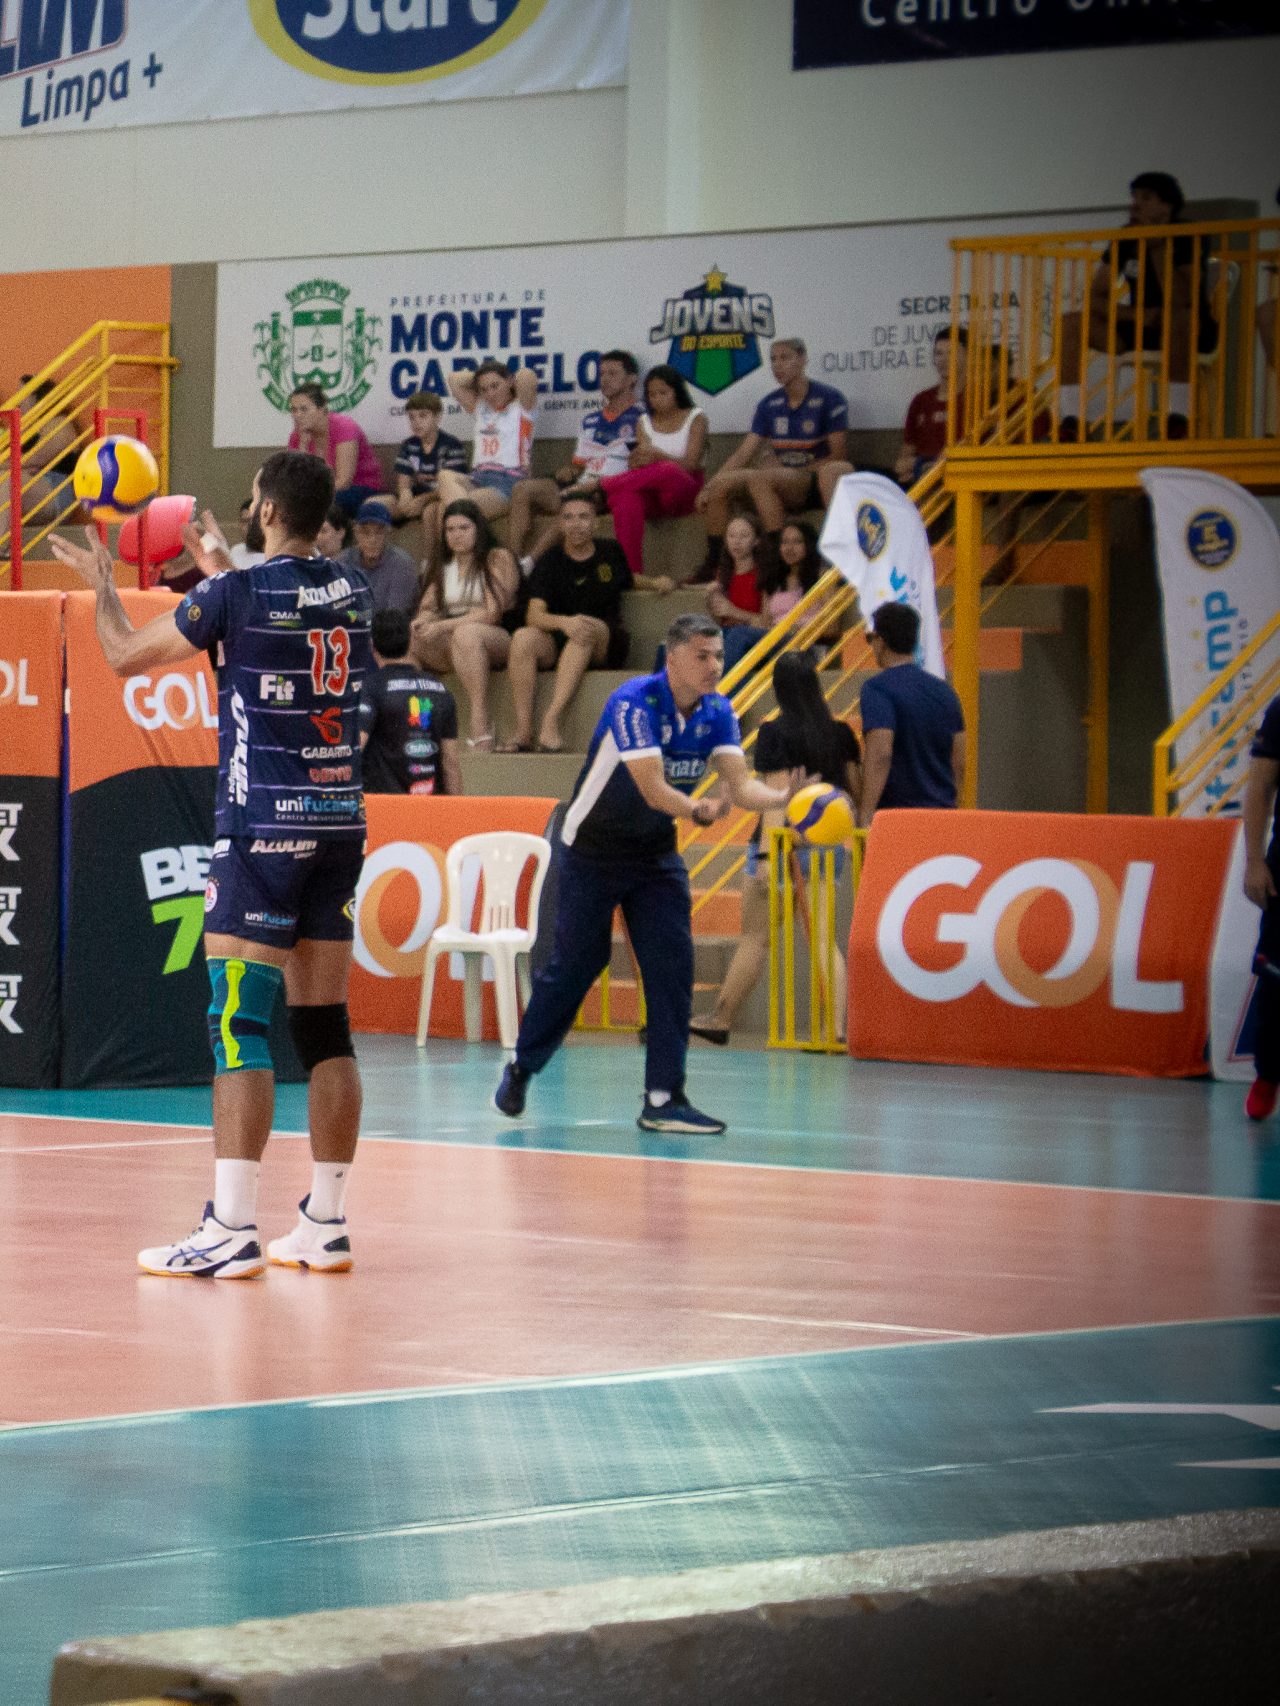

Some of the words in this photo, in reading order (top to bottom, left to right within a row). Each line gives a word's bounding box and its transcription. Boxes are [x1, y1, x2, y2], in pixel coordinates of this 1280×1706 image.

[21, 59, 130, 128] Limpa
[390, 291, 508, 307] PREFEITURA
[524, 289, 546, 301] DE
[650, 293, 775, 344] JOVENS
[390, 307, 545, 354] MONTE
[874, 325, 898, 347] DE
[822, 349, 909, 373] CULTURA
[270, 610, 301, 620] CMAA
[308, 626, 350, 696] 13
[122, 671, 219, 731] GOL
[259, 673, 296, 700] Fit
[140, 844, 216, 900] BE
[876, 854, 1184, 1013] GOL
